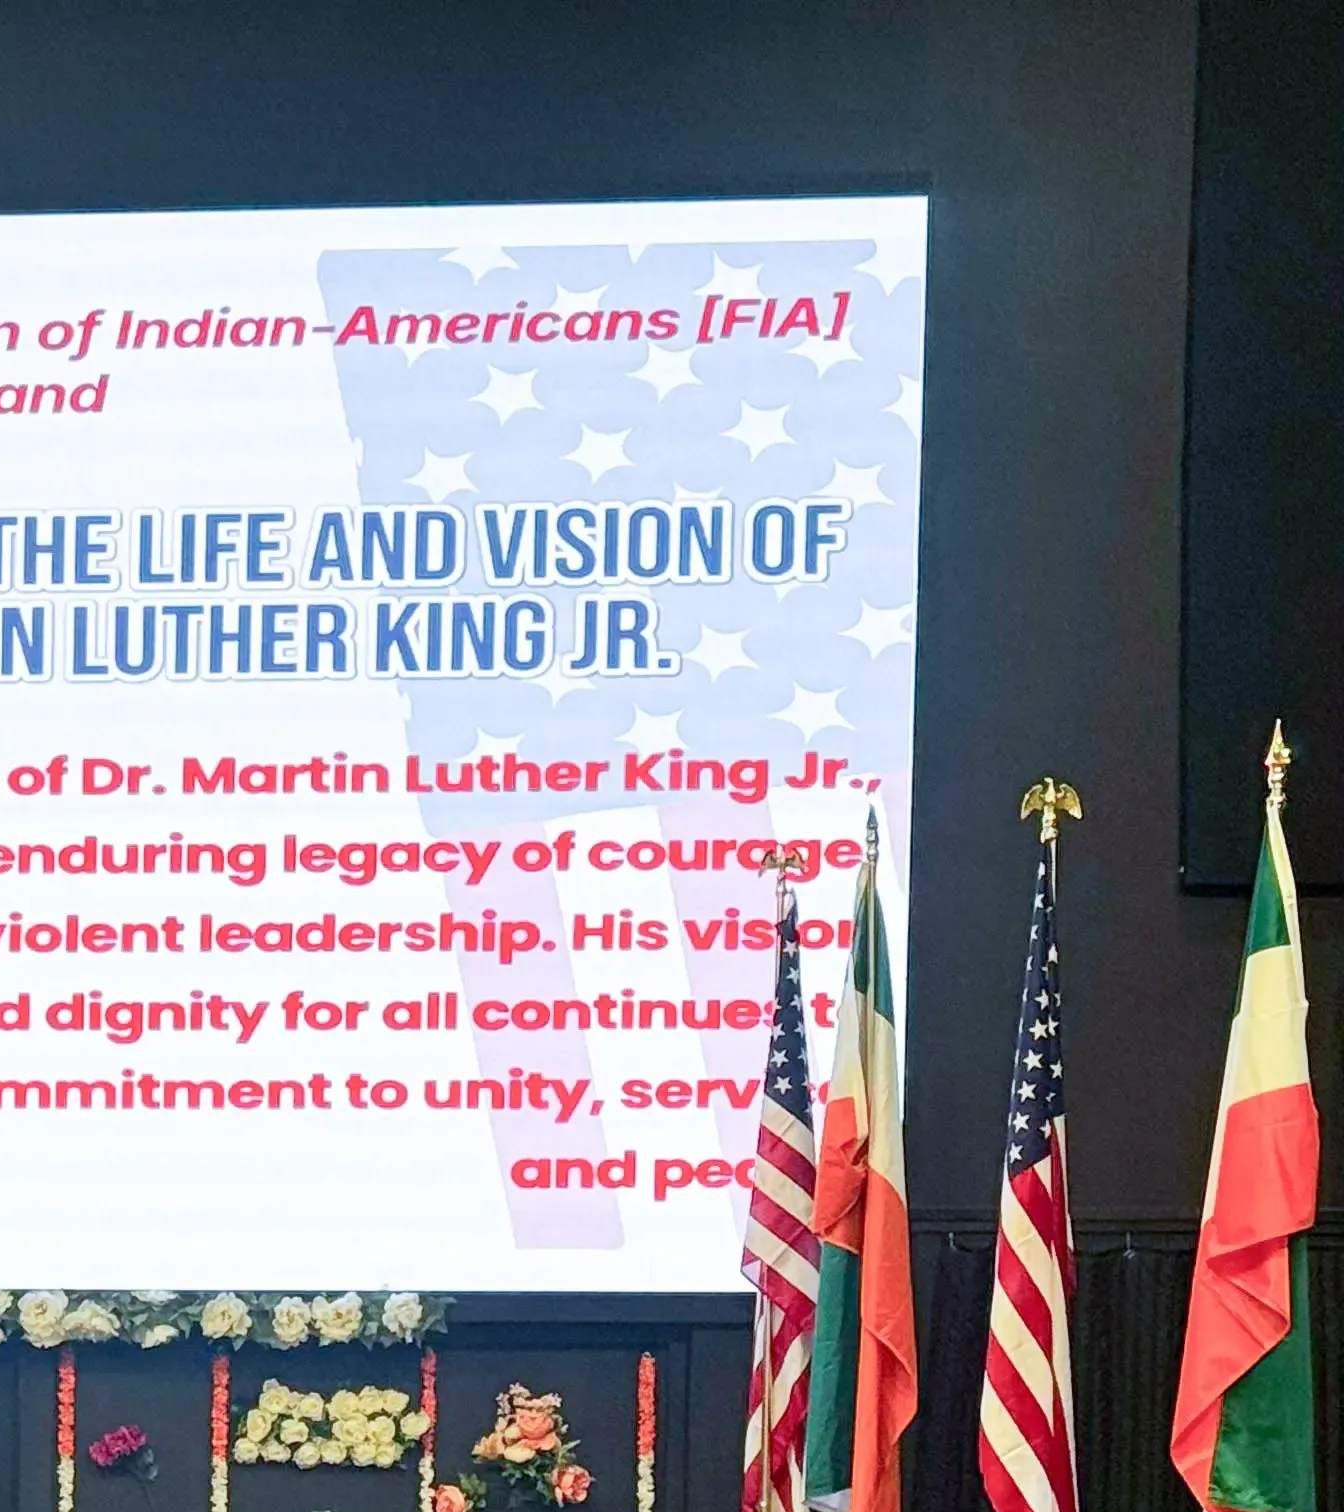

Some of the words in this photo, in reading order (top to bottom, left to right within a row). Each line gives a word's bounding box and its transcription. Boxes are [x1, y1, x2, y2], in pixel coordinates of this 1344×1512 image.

[36, 309, 106, 360] of
[115, 303, 680, 350] Indian-Americans
[696, 290, 851, 346] [FIA]
[137, 512, 284, 584] LIFE
[309, 510, 457, 582] AND
[482, 505, 724, 580] VISION
[751, 503, 843, 577] OF
[72, 603, 348, 676] LUTHER
[375, 602, 546, 674] KING
[570, 600, 674, 671] JR.
[6, 754, 68, 796] of
[81, 757, 166, 796] Dr.
[181, 752, 390, 795] Martin
[404, 752, 610, 794] Luther
[623, 748, 771, 804] King
[784, 750, 883, 795] Jr.,
[282, 833, 502, 887] legacy
[511, 830, 577, 874] of
[199, 907, 557, 966] leadership.
[570, 909, 670, 952] His
[44, 990, 269, 1045] dignity
[280, 990, 370, 1032] for
[382, 991, 460, 1031] all
[344, 1072, 411, 1110] to
[423, 1066, 604, 1125] unity,
[509, 1150, 639, 1190] and
